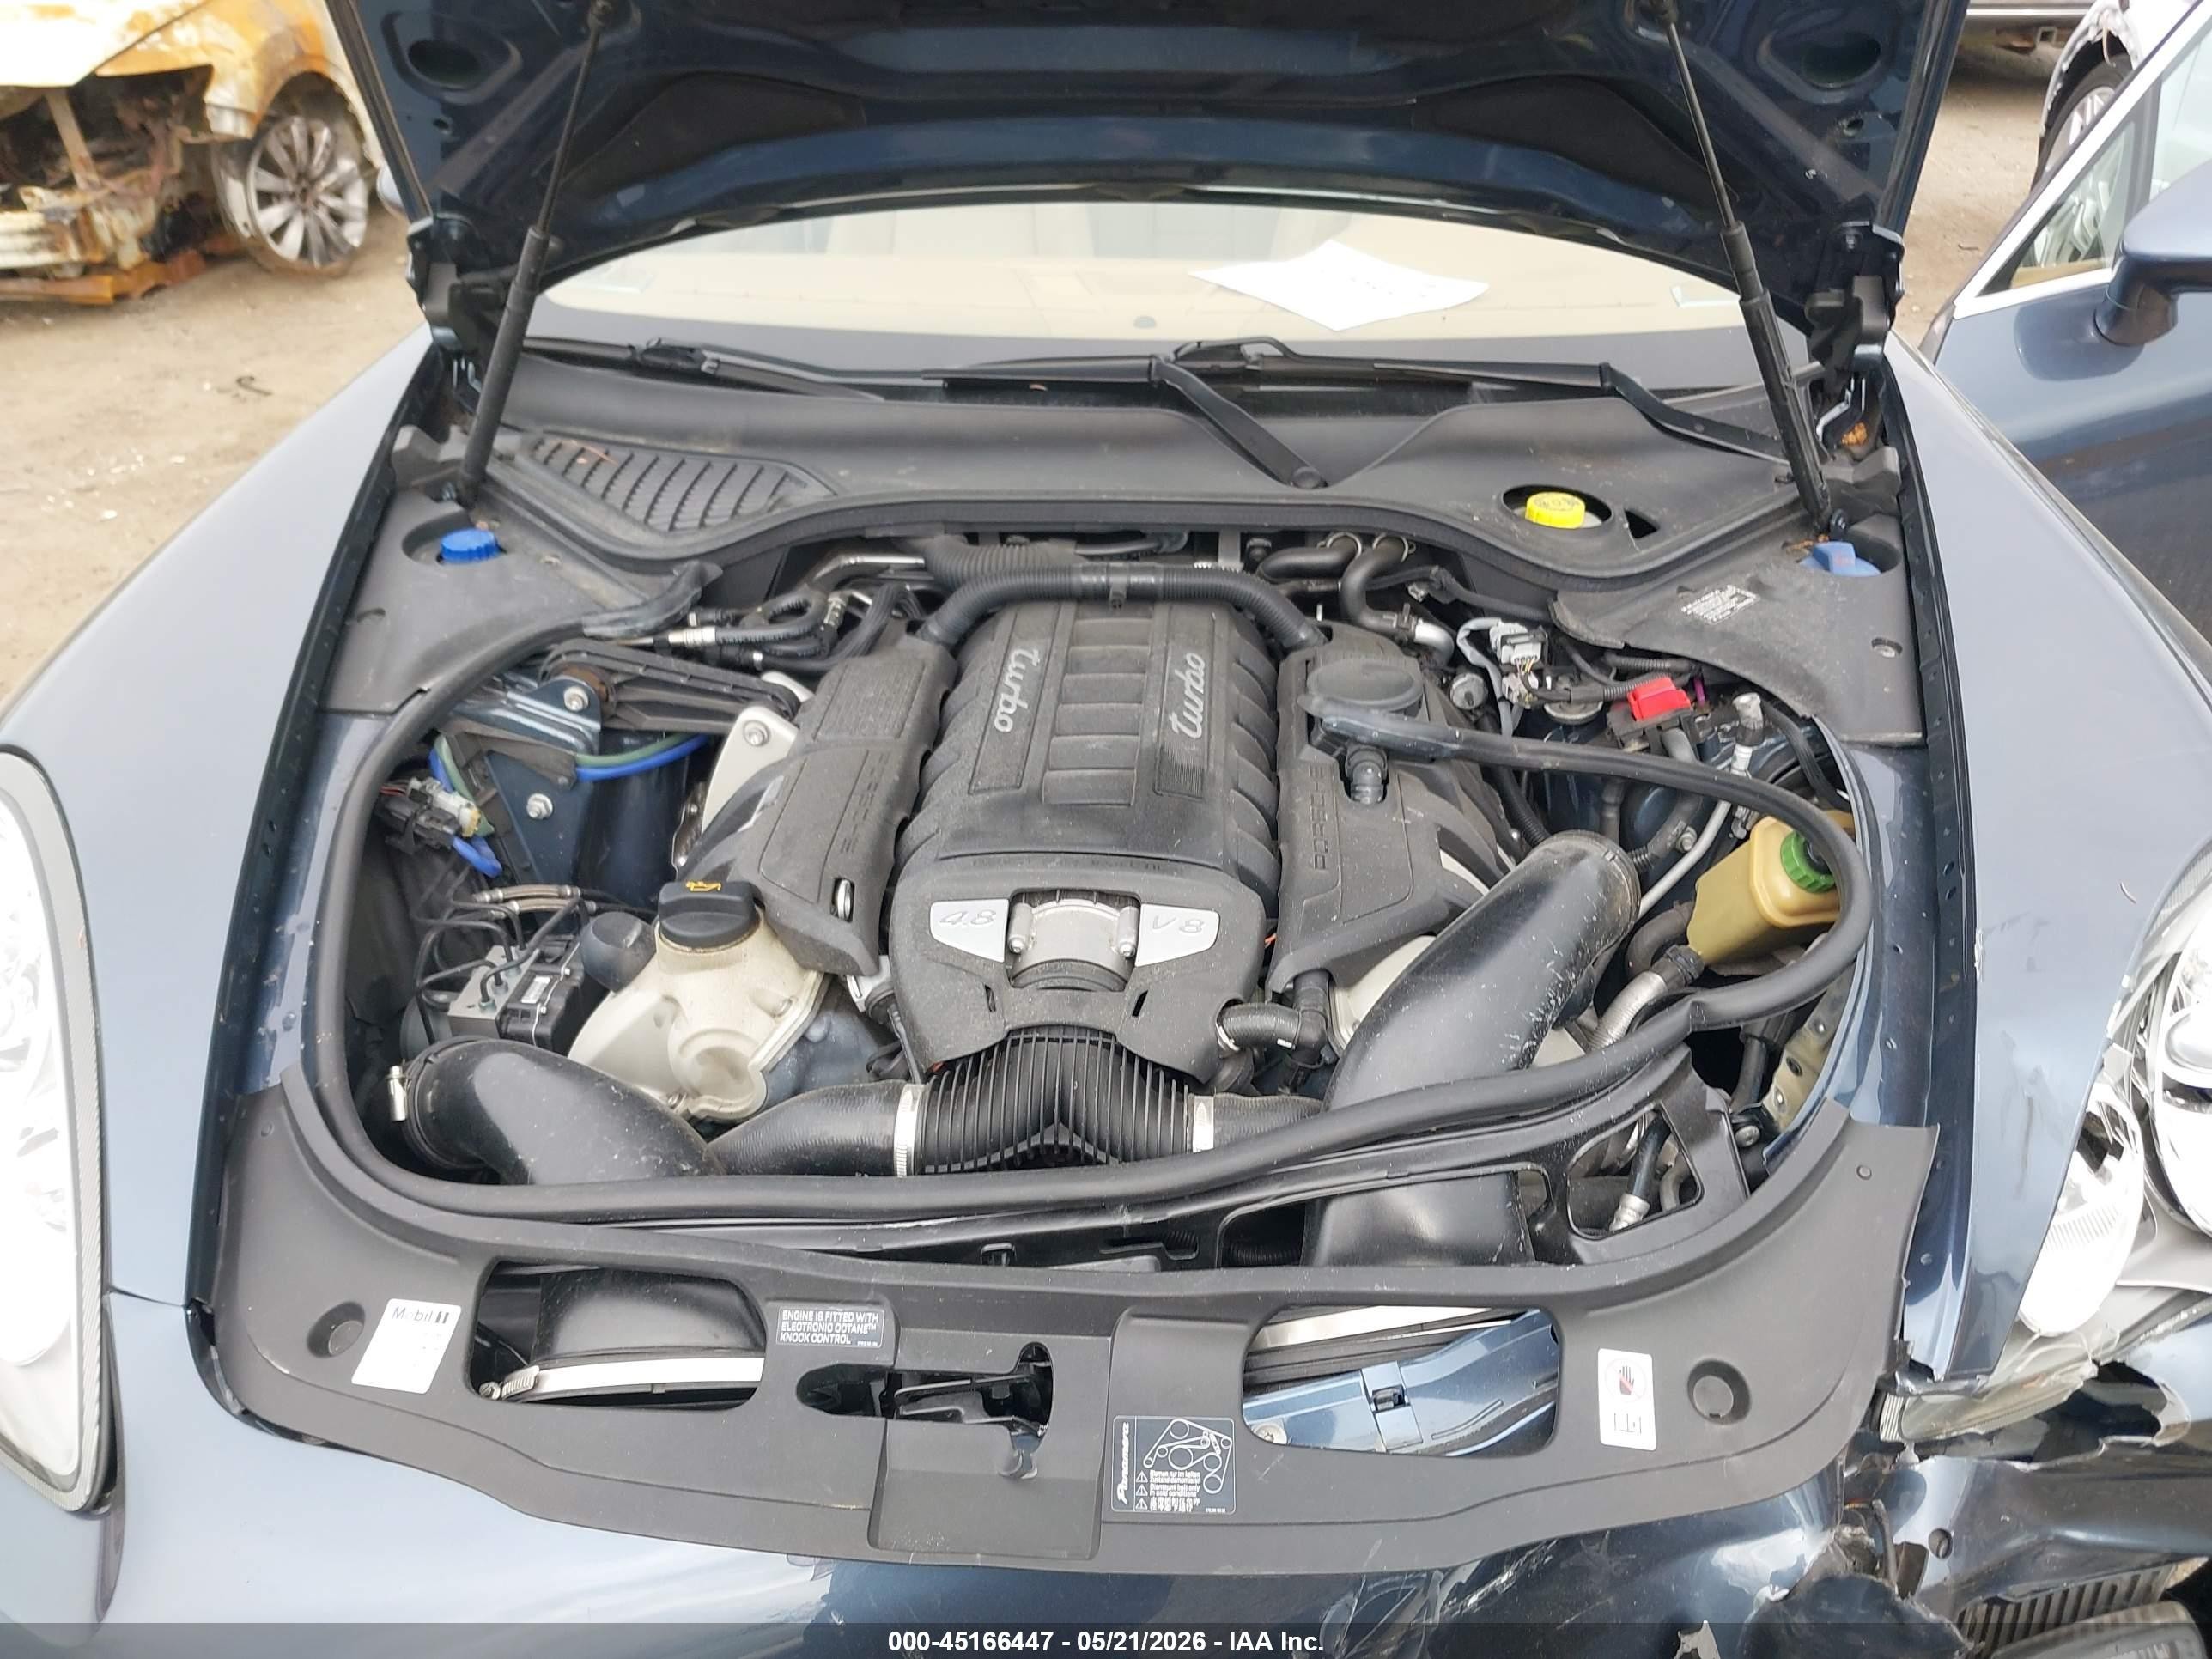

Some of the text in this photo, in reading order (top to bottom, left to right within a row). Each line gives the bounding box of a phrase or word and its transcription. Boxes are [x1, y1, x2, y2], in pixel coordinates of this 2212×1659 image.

[994, 647, 1042, 733] turbo
[1168, 653, 1206, 739] turbo
[938, 908, 997, 929] 4.8
[782, 1310, 813, 1321] ENGINE
[825, 1311, 854, 1322] FITTED
[855, 1312, 879, 1323] WITH
[811, 1333, 851, 1345] CONTROL
